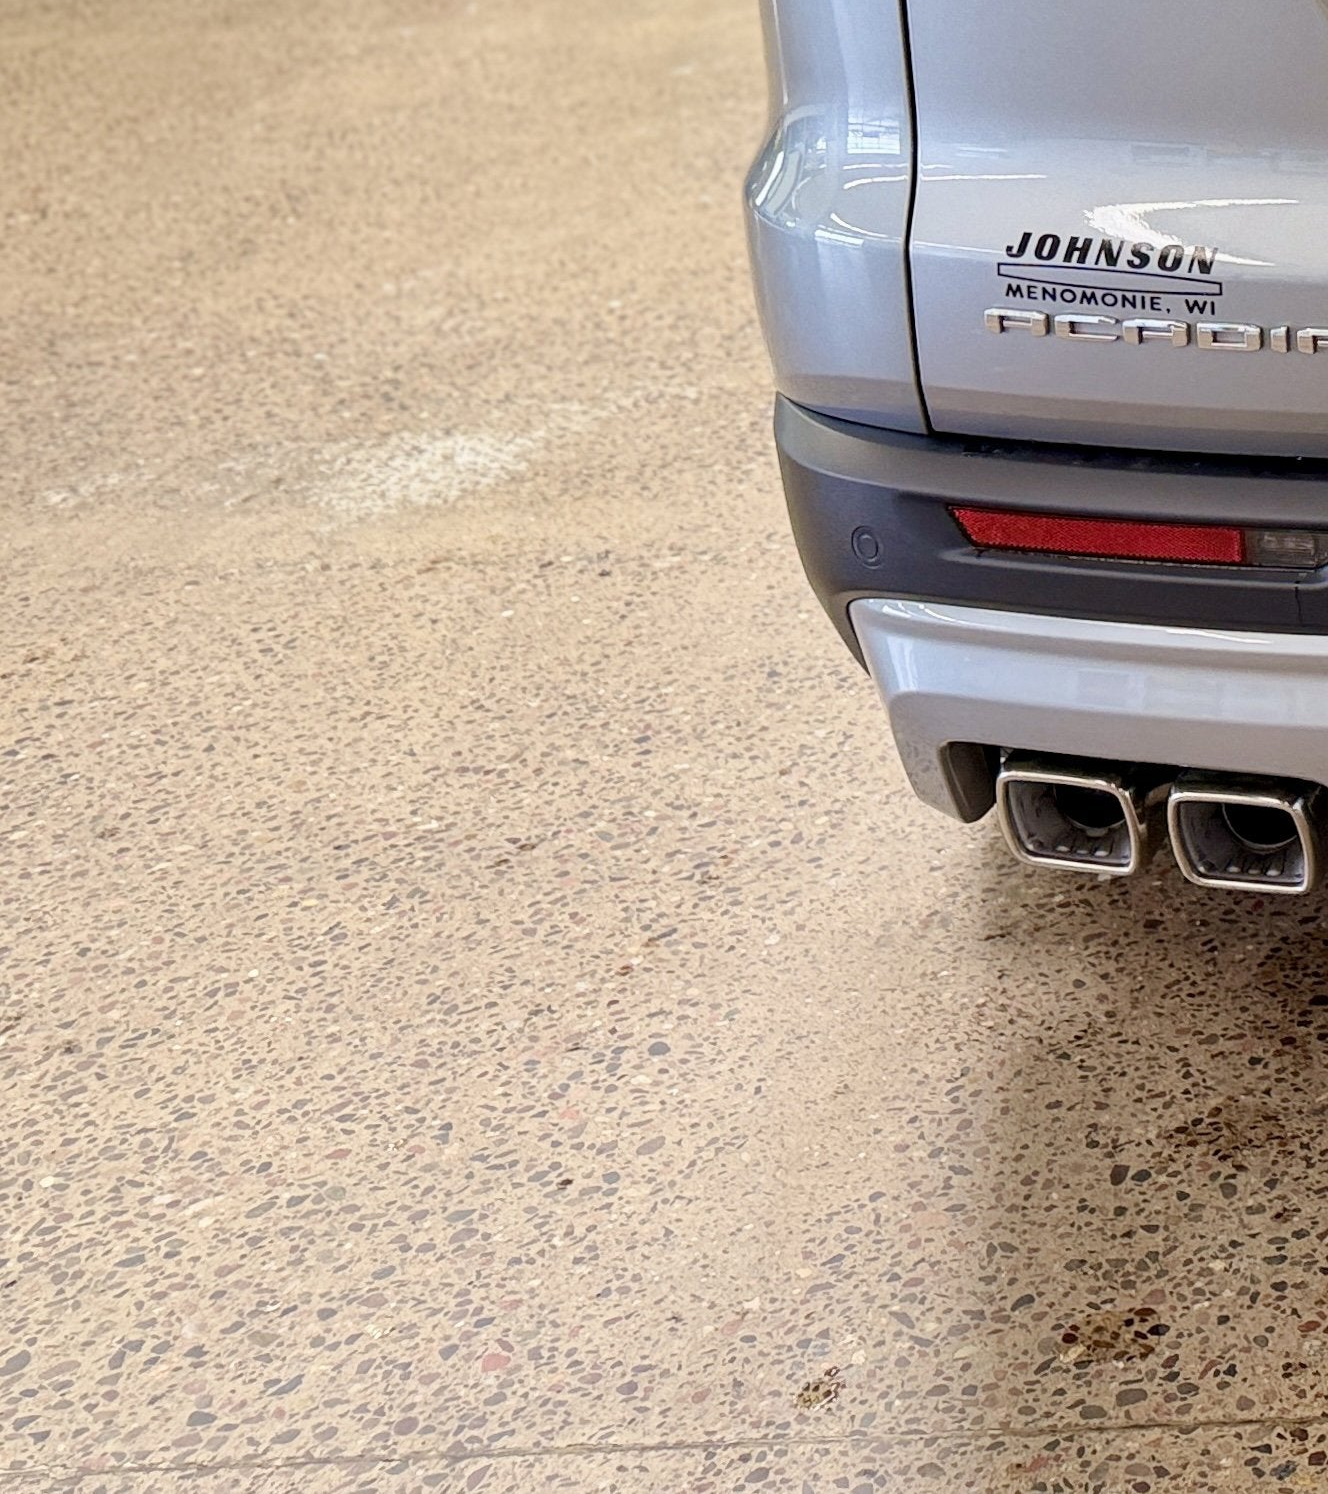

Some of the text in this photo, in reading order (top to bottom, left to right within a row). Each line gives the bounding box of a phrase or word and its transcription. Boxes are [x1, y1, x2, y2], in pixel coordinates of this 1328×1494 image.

[1005, 232, 1218, 274] JOHNSON
[1005, 283, 1216, 315] MENOMONIE, WI
